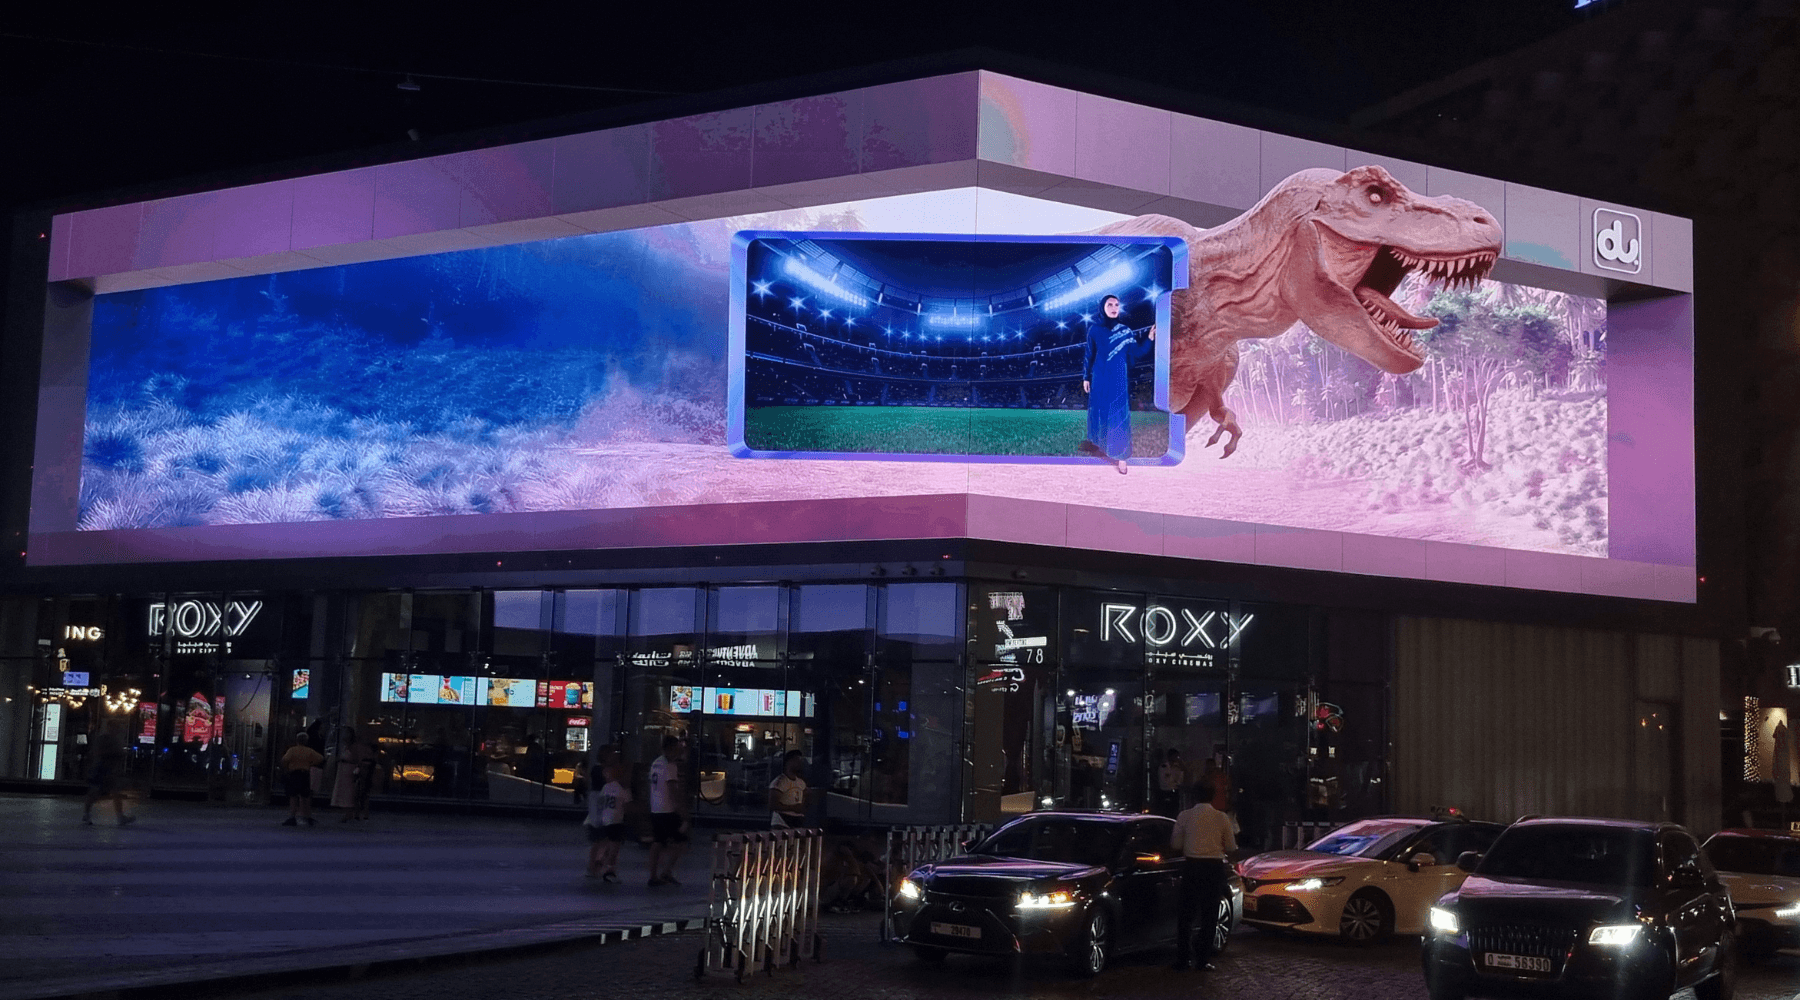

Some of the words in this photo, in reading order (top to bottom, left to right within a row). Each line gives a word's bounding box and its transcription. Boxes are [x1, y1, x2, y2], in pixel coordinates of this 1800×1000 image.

[64, 625, 102, 641] ING
[1100, 602, 1255, 649] ROXY
[1026, 648, 1044, 664] 78
